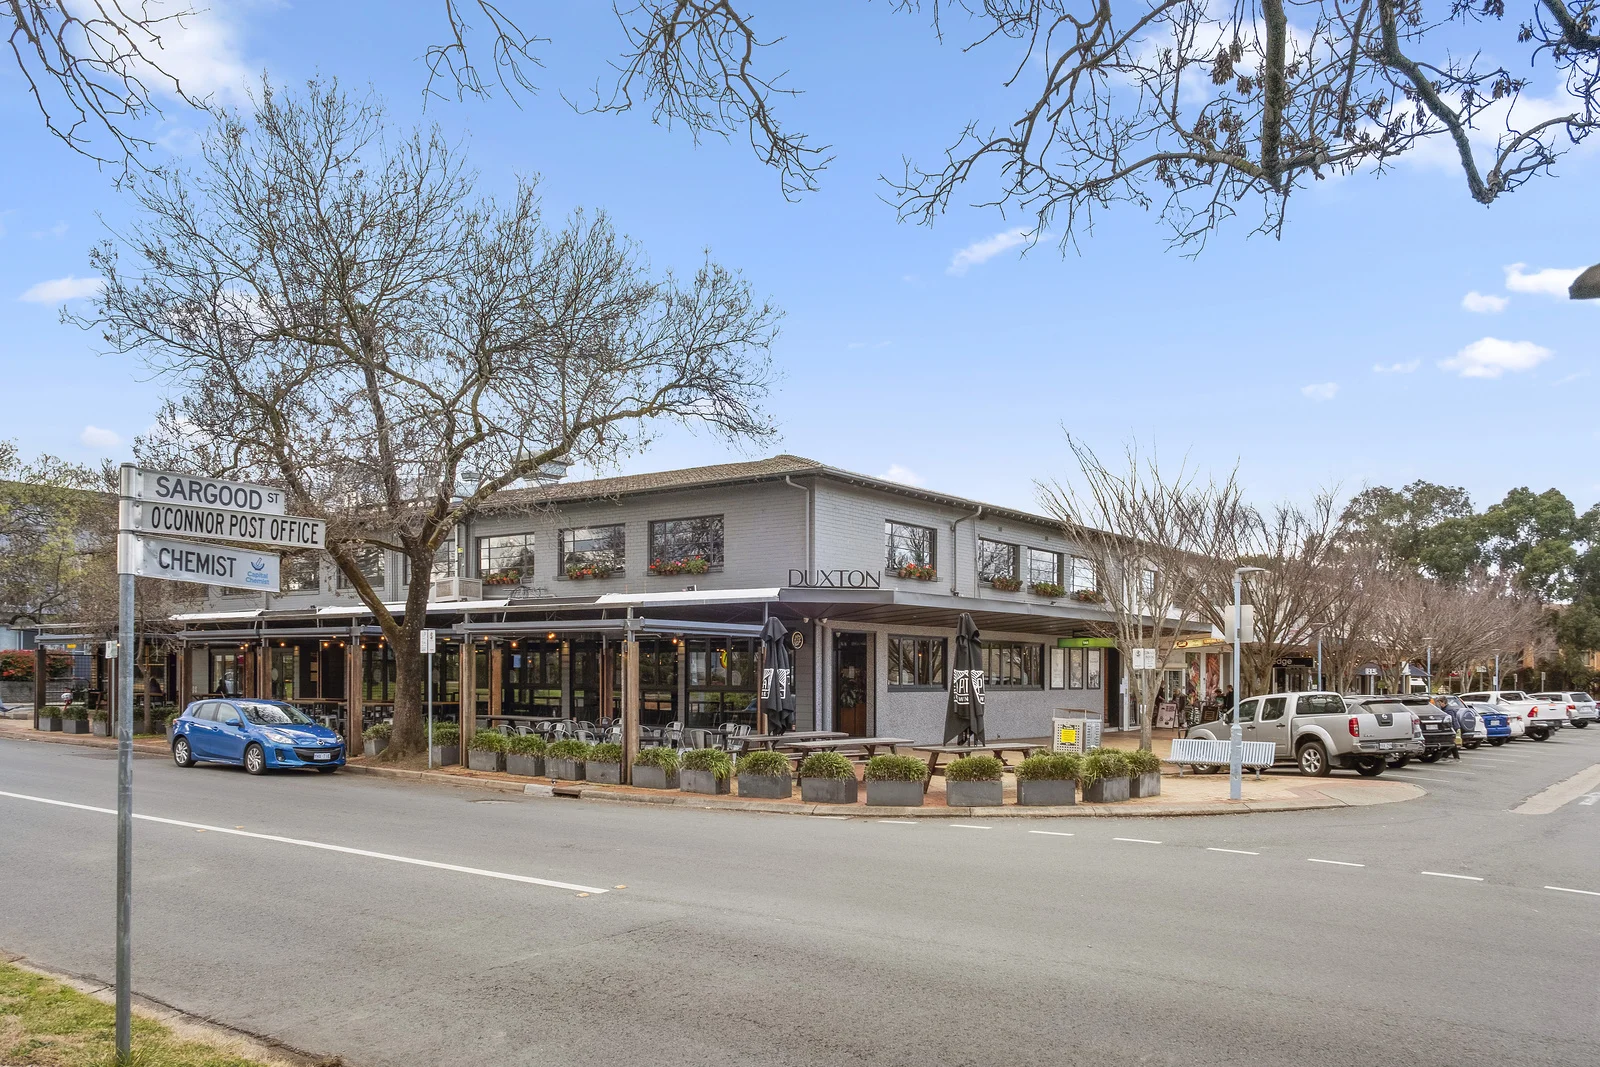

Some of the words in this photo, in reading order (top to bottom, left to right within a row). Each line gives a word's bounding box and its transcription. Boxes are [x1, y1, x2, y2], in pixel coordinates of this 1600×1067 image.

[156, 476, 262, 510] SARGOOD
[267, 492, 280, 504] ST
[151, 506, 224, 535] O'CONNOR
[230, 514, 266, 539] POST
[270, 518, 319, 544] OFFICE
[158, 547, 237, 578] CHEMIST
[247, 571, 269, 579] Capital
[245, 577, 270, 585] Chemist
[788, 568, 881, 587] DUXTON
